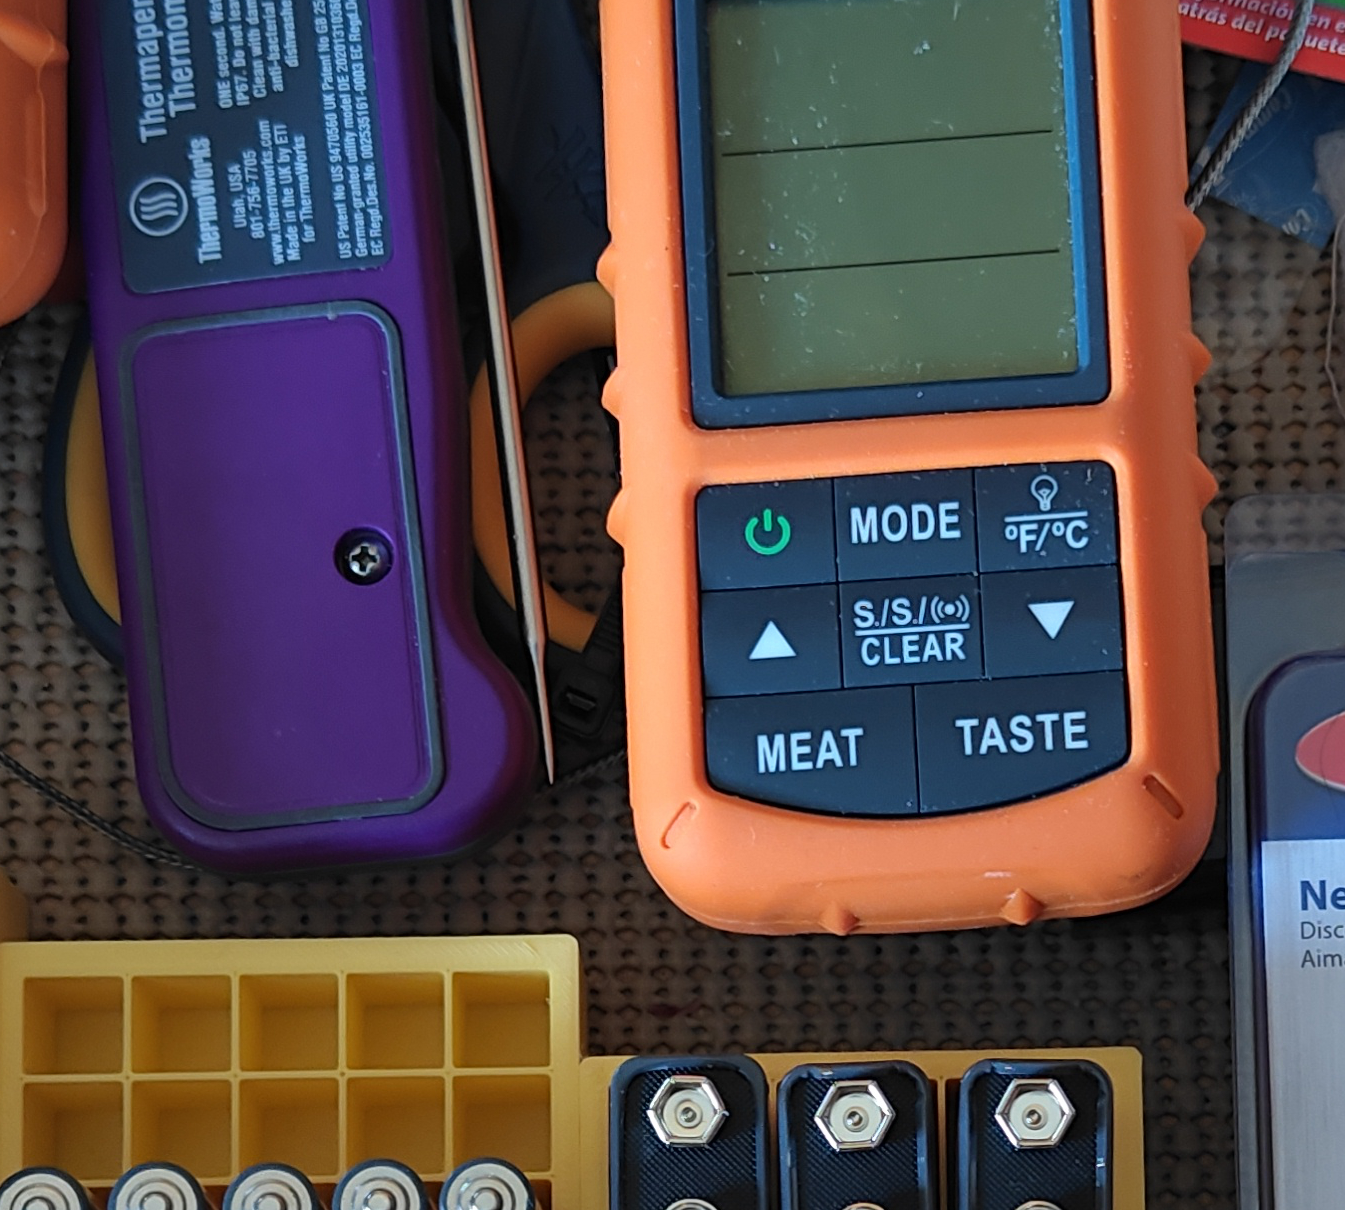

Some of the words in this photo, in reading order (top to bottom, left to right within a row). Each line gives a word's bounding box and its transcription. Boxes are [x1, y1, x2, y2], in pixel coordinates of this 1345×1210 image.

[228, 23, 244, 46] not
[314, 18, 328, 33] GB
[1178, 3, 1228, 26] atrás
[1231, 14, 1263, 36] del
[212, 26, 230, 78] second.
[232, 49, 246, 67] Do
[248, 28, 262, 57] with
[262, 2, 284, 92] anti-bacterial
[317, 36, 330, 52] No
[350, 44, 363, 60] EC
[234, 70, 250, 106] IP67.
[252, 59, 267, 98] Clean
[319, 54, 335, 90] Patent
[337, 75, 350, 91] DE
[217, 80, 233, 108] ONE
[322, 93, 337, 110] UK
[339, 94, 354, 128] model
[352, 63, 374, 159] 002535161-0003
[325, 113, 342, 163] 9470560
[344, 131, 358, 162] utility
[276, 147, 293, 163] by
[227, 164, 243, 191] USA
[278, 165, 292, 184] UK
[293, 135, 313, 222] ThermoWorks
[331, 165, 344, 181] US
[188, 137, 222, 263] ThermoWorks
[243, 150, 265, 239] 801-756-7705
[258, 119, 284, 265] www.thermoworks.com
[281, 188, 295, 207] the
[333, 184, 346, 200] No
[363, 162, 383, 238] Regd.Des.No.
[232, 195, 247, 228] Utah,
[284, 211, 296, 222] in
[335, 202, 350, 239] Patent
[347, 166, 368, 257] German-granted
[286, 226, 301, 261] Made
[301, 224, 315, 242] for
[338, 241, 352, 258] US
[371, 240, 384, 256] EC
[850, 502, 961, 544] MODE
[1005, 520, 1089, 553] °F/°C
[861, 633, 966, 666] CLEAR
[955, 711, 1089, 755] TASTE
[757, 727, 864, 773] MEAT
